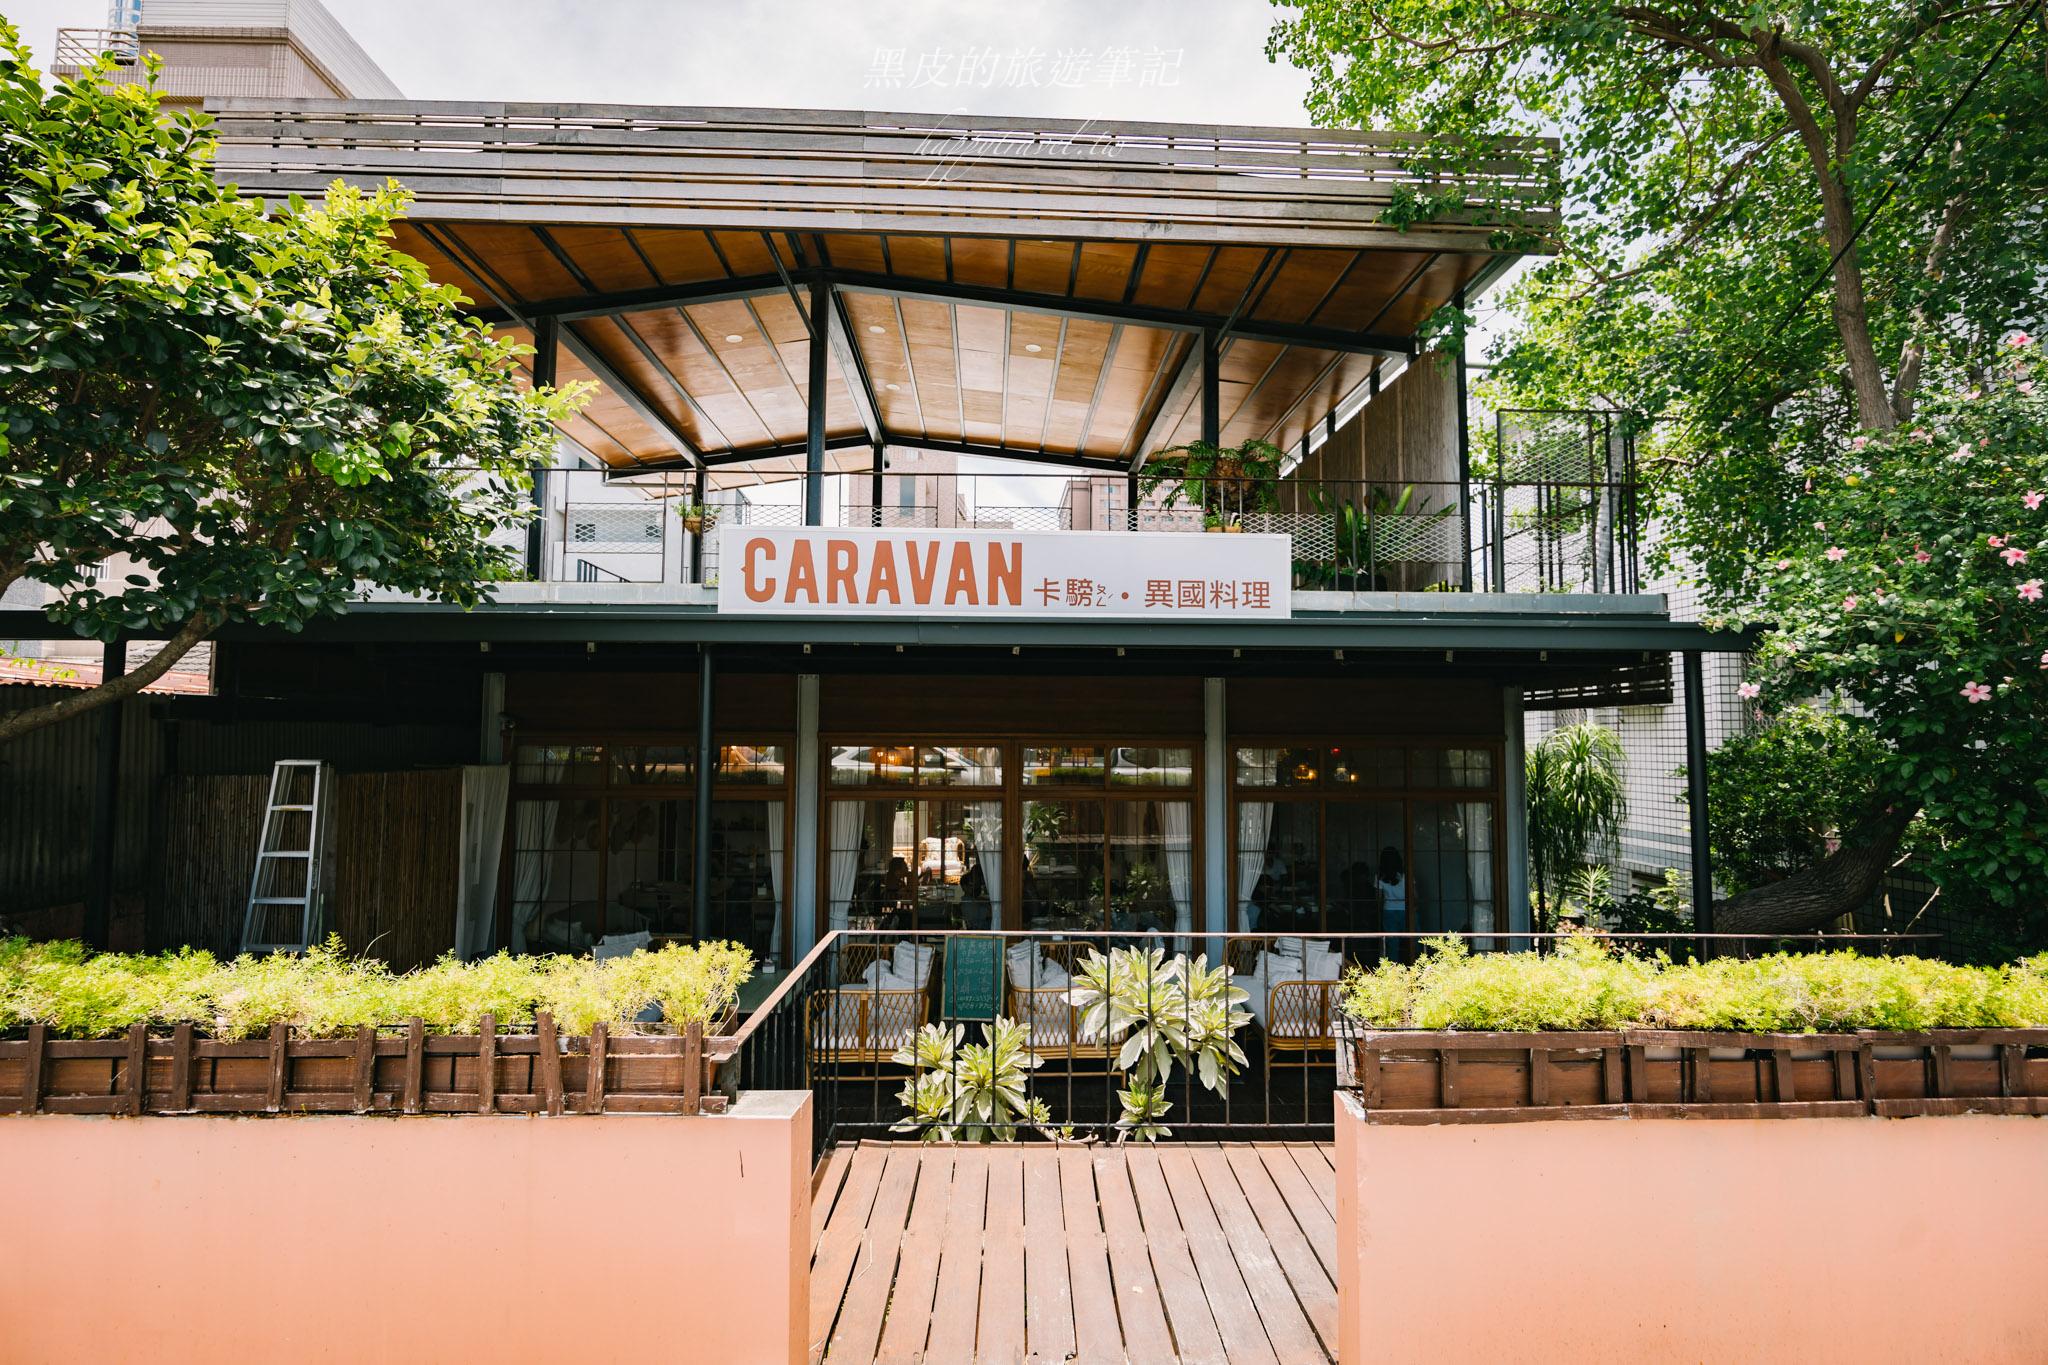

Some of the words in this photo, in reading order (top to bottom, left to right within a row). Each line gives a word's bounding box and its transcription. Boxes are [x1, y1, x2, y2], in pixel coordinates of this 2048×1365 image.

[740, 537, 1023, 606] CARAVAN
[1144, 579, 1271, 609] 異國料理
